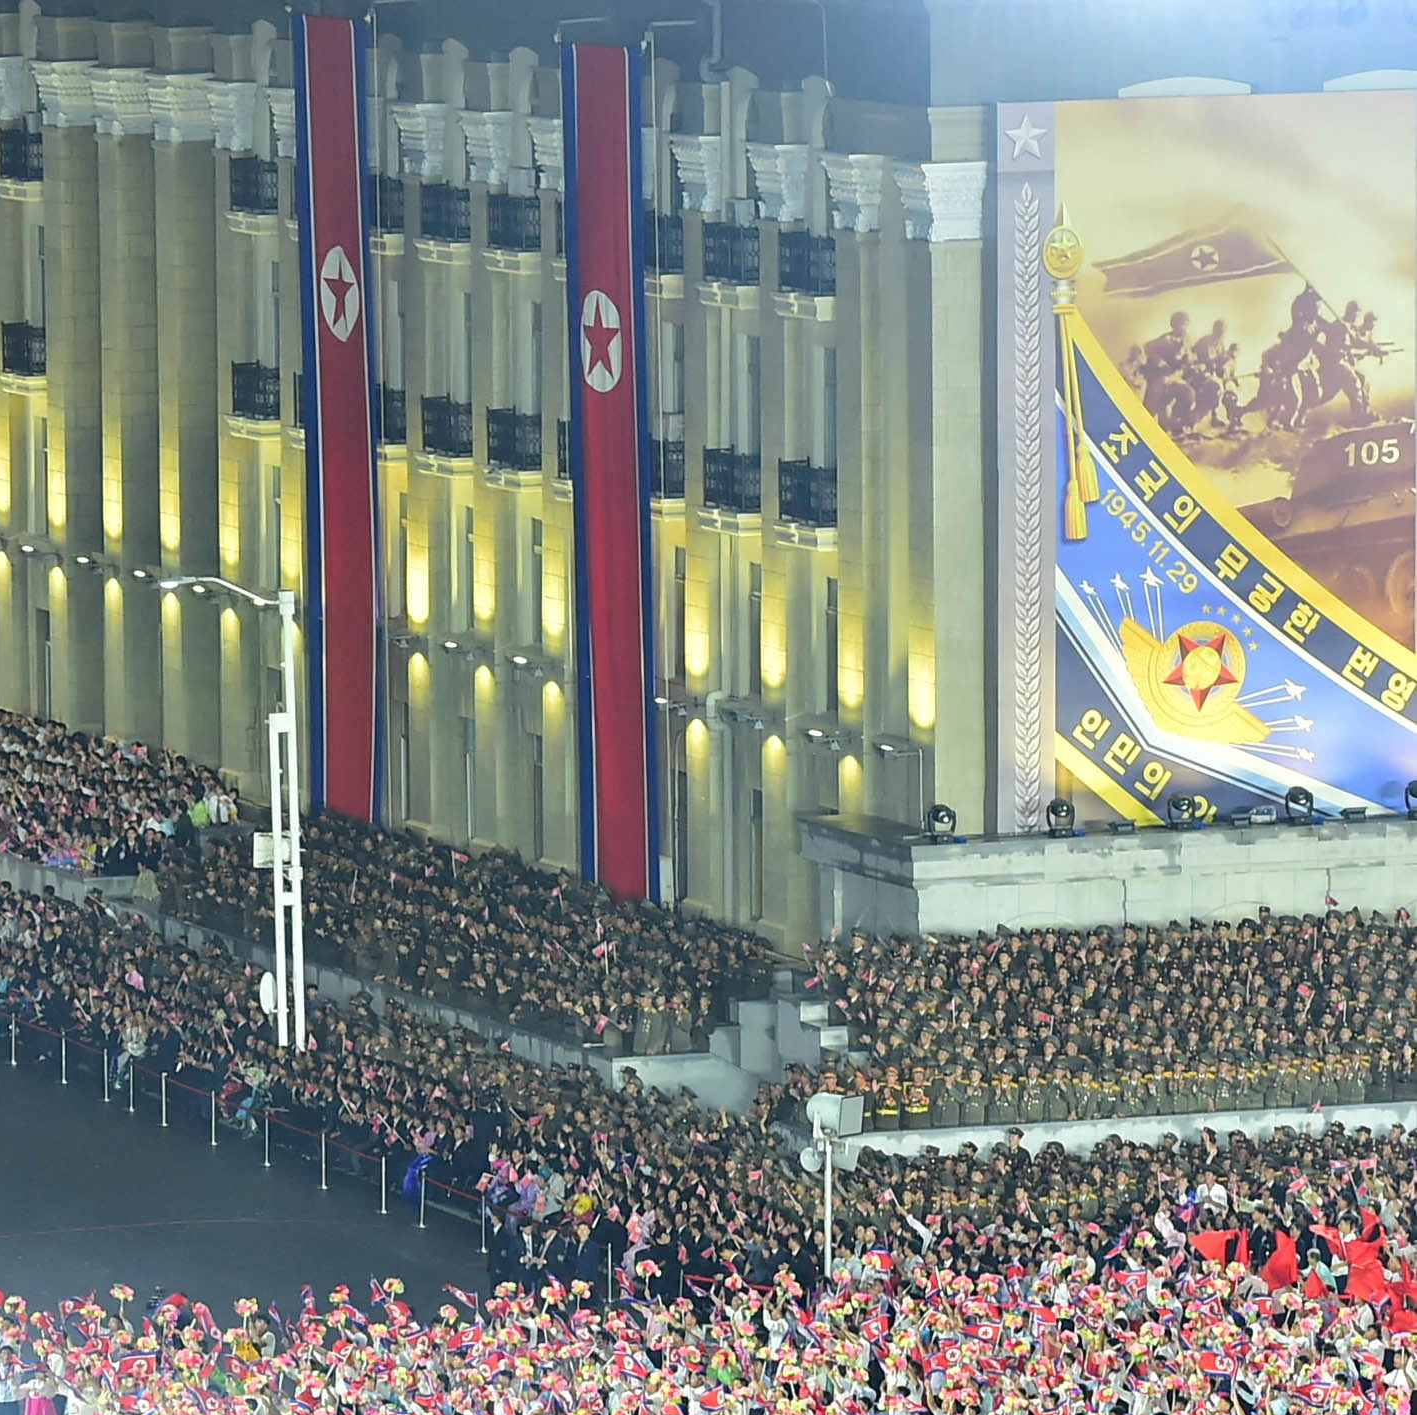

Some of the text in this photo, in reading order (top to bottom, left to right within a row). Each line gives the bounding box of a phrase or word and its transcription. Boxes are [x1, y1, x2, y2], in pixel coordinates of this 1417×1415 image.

[1345, 438, 1400, 468] 105
[1100, 422, 1202, 535] 조국의
[1214, 542, 1322, 644] 무궁한
[1071, 708, 1173, 801] 인민의
